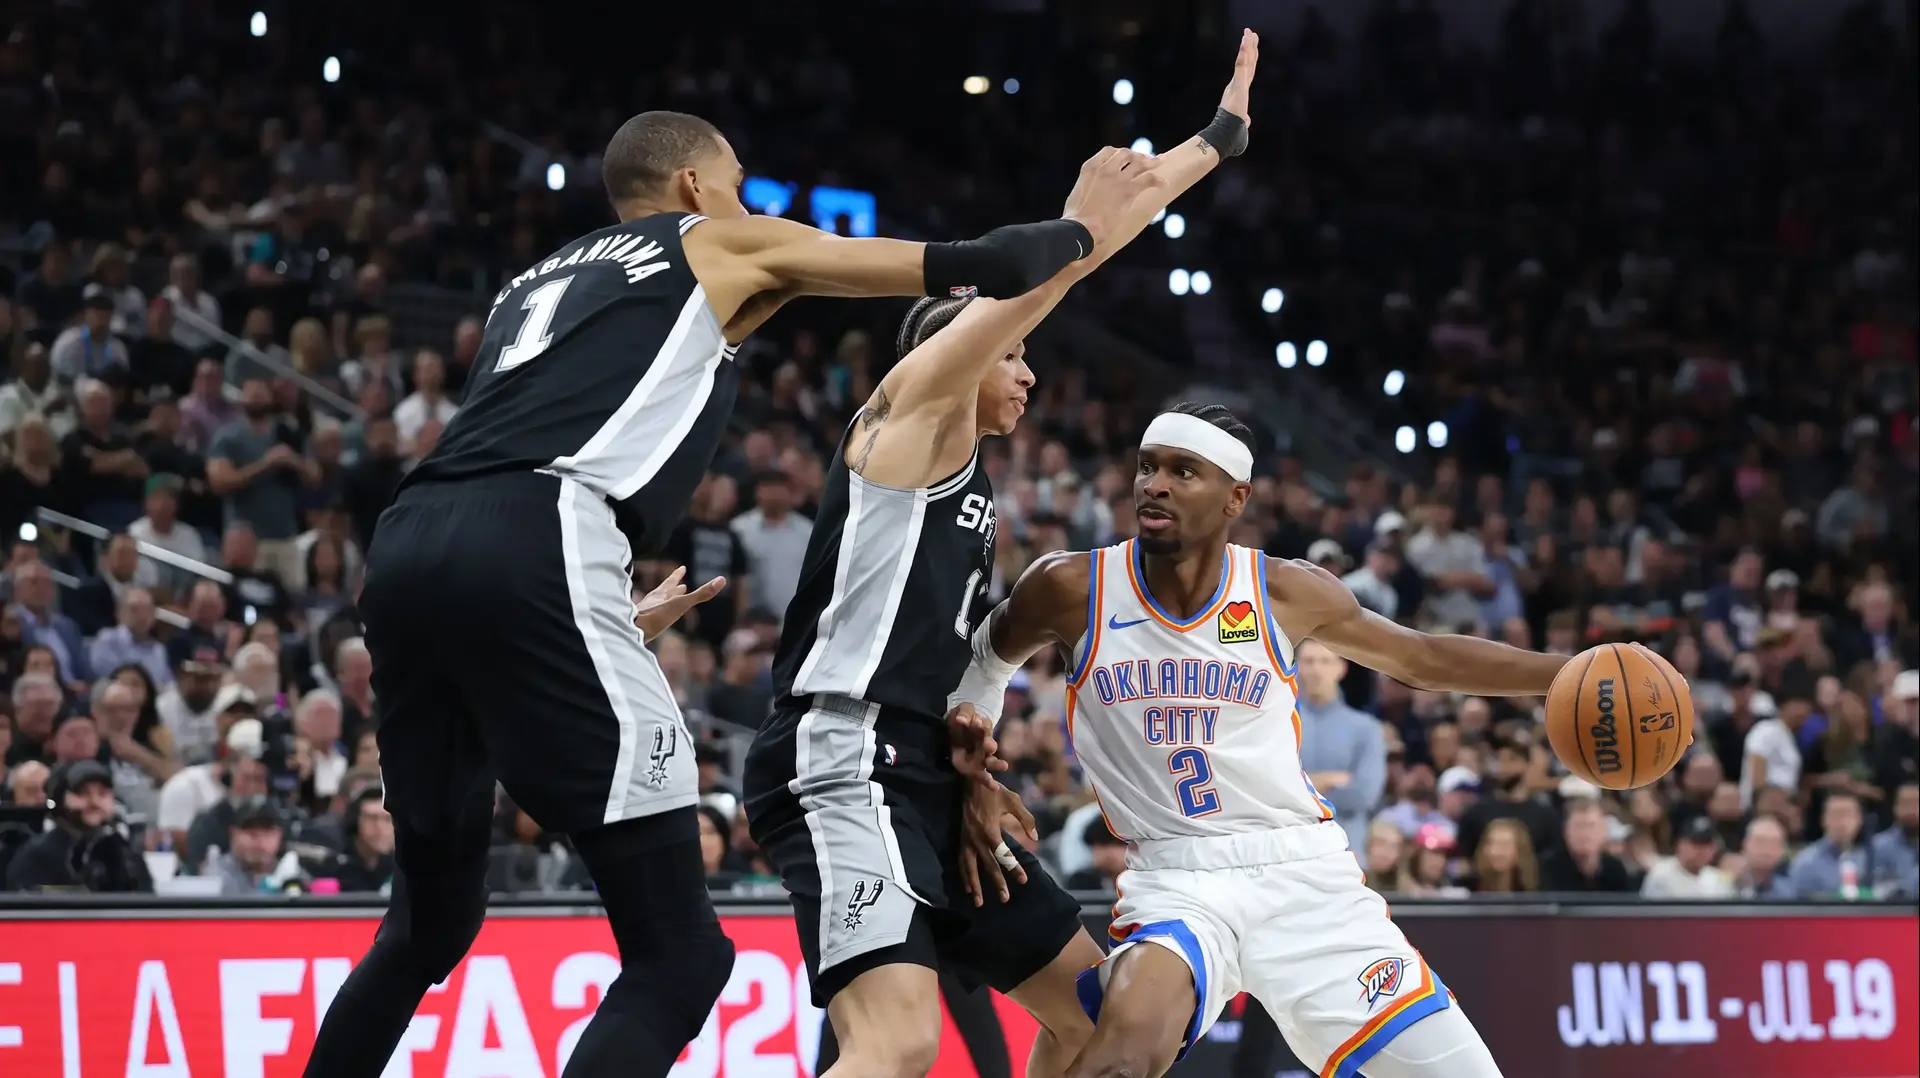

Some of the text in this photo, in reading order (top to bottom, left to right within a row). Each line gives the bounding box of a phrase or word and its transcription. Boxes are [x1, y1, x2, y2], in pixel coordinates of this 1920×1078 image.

[484, 233, 671, 330] EMBANYAMA
[493, 274, 576, 373] 1
[954, 568, 989, 640] 1
[1092, 658, 1272, 708] OKLAHOMA
[1144, 706, 1220, 745] CITY
[1591, 678, 1622, 774] Wilson
[1167, 746, 1222, 818] 2
[1367, 962, 1395, 1003] OKC
[1557, 961, 1646, 1047] JUN
[1646, 961, 1718, 1044] 11
[1748, 959, 1825, 1043] JUL
[1824, 956, 1898, 1041] 19
